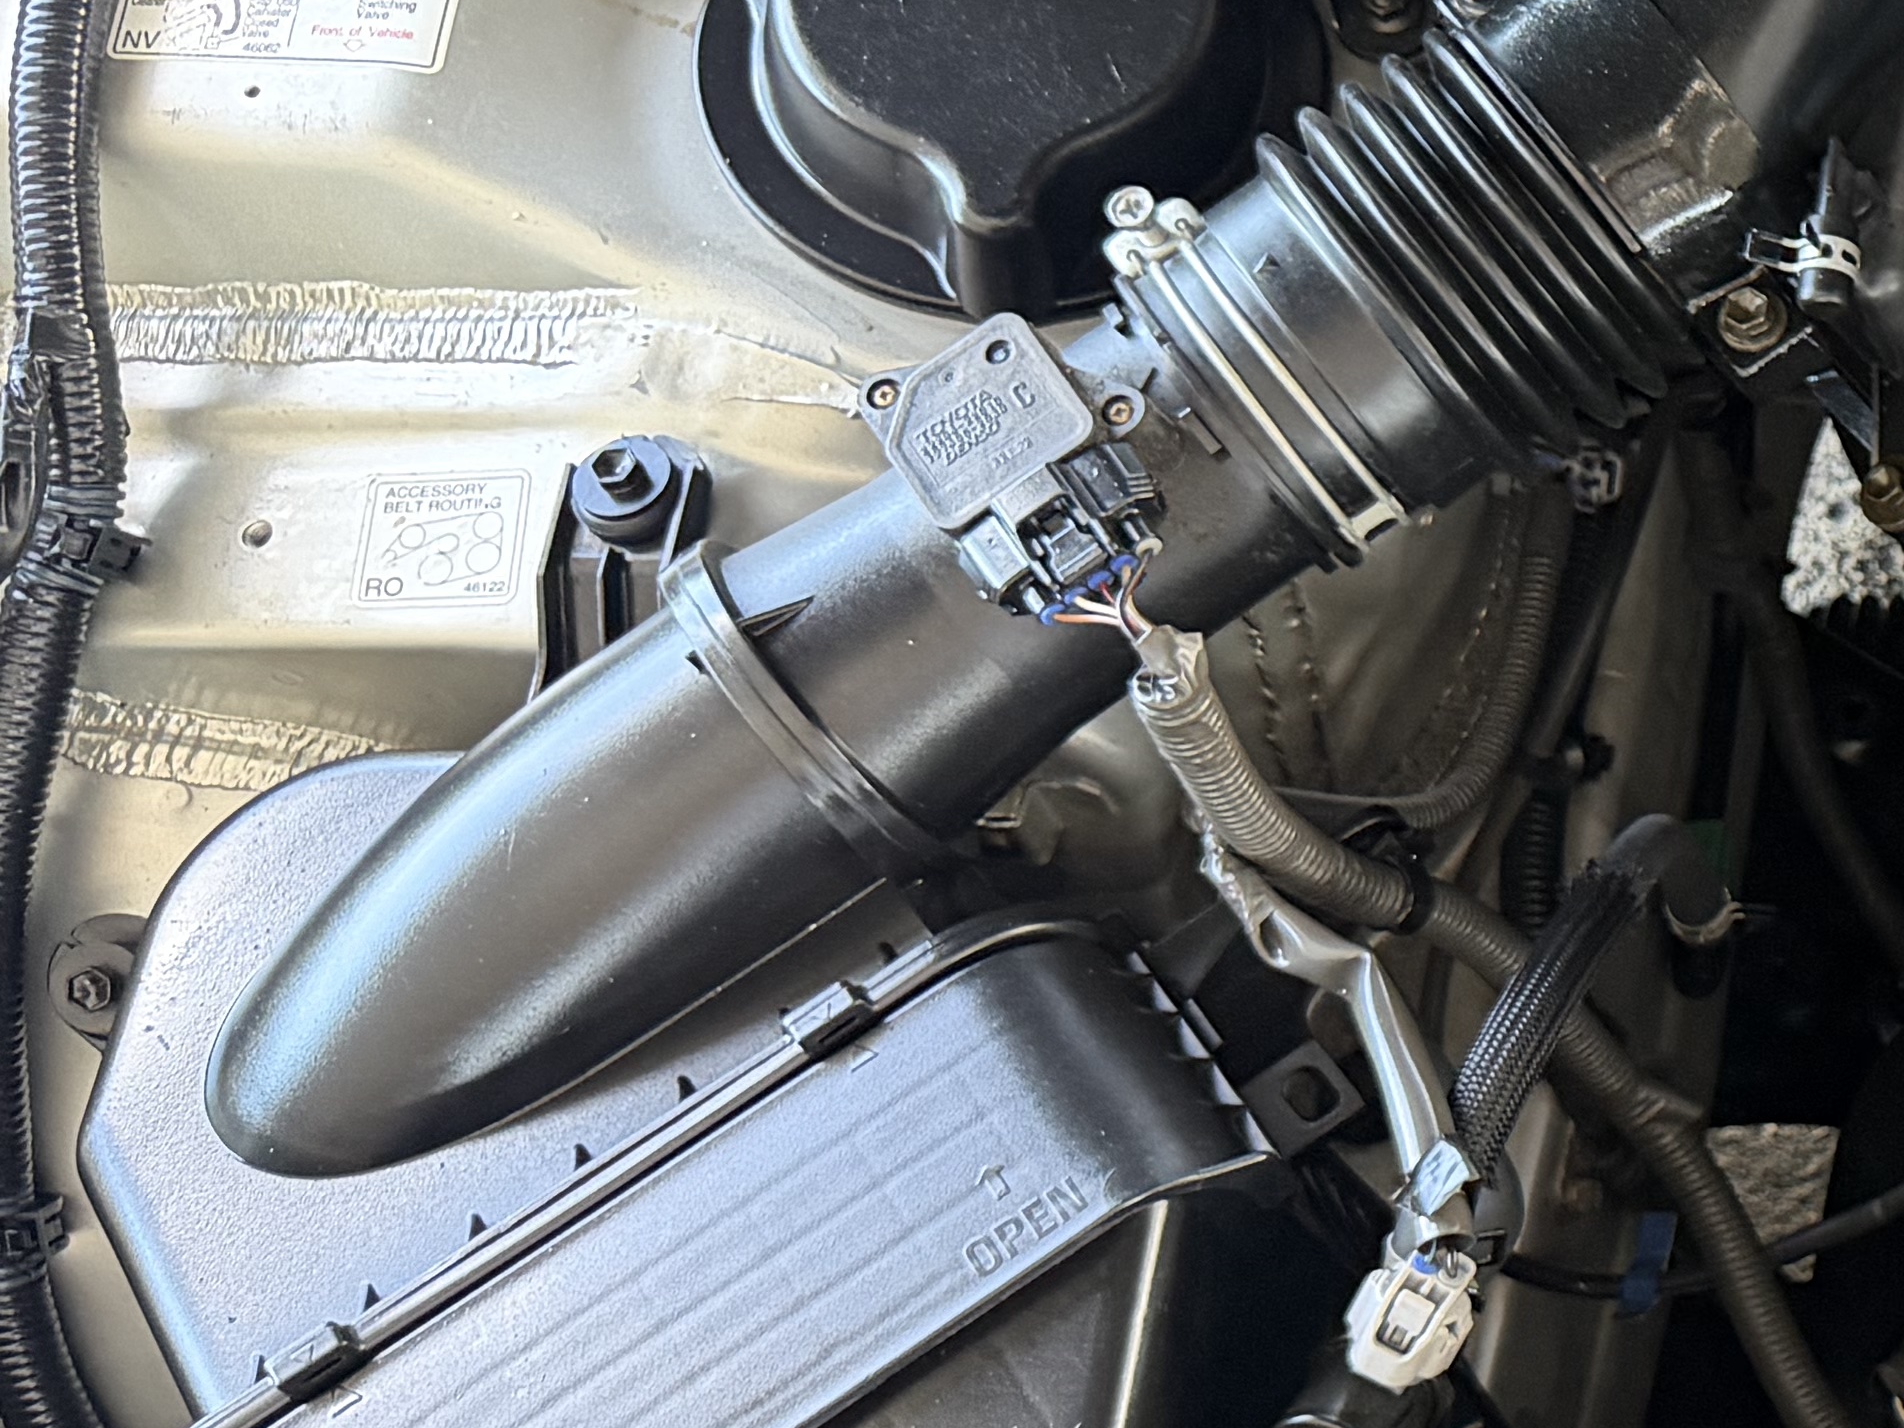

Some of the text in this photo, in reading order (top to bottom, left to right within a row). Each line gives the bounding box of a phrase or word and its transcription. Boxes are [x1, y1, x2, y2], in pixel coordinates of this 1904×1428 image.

[122, 30, 161, 48] NV
[311, 24, 344, 37] Front
[369, 26, 414, 40] Vehicle
[1012, 381, 1036, 410] C
[916, 388, 994, 443] TOYOTA
[385, 483, 488, 499] ACCESSORY
[384, 501, 423, 514] BELT
[364, 577, 404, 597] RO
[464, 581, 506, 593] 46122
[964, 1176, 1090, 1278] OPEN
